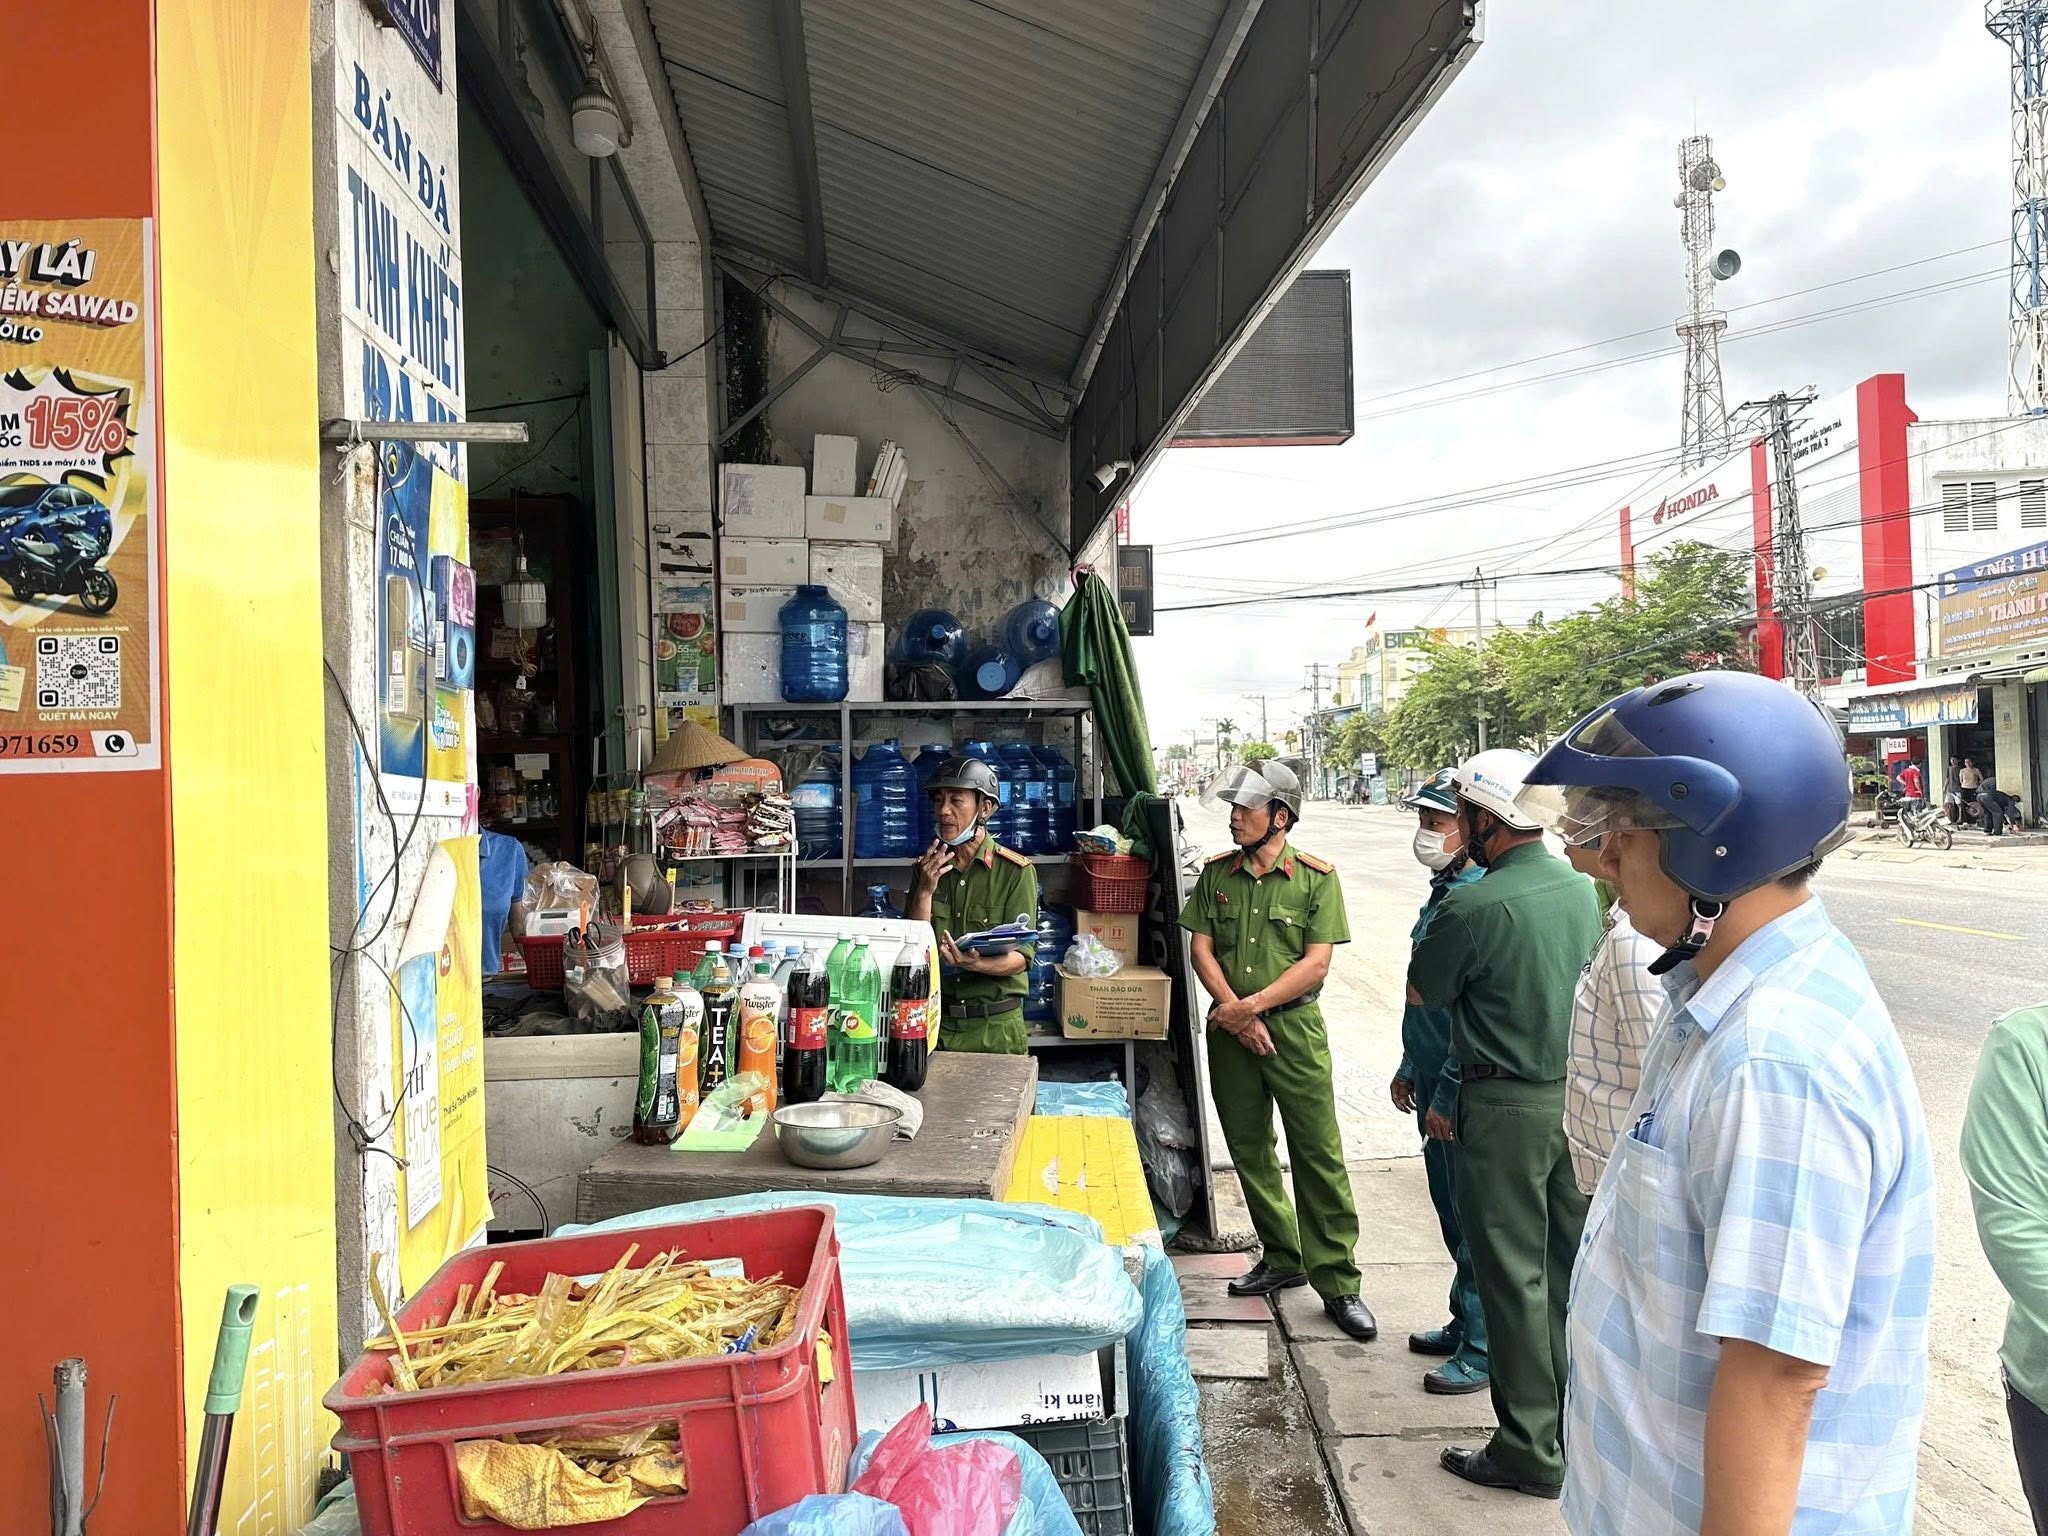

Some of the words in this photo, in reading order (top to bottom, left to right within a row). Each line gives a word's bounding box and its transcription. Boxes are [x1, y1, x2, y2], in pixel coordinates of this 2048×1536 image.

[38, 238, 97, 282] LÁI
[45, 290, 139, 325] SAWAD
[22, 325, 44, 342] LO
[25, 396, 127, 453] 15%
[1667, 483, 1719, 519] HONDA
[38, 711, 67, 721] QUÉT
[89, 712, 118, 720] NGAY
[709, 1008, 727, 1065] TEA
[407, 1096, 437, 1142] true
[1040, 1394, 1060, 1408] ki
